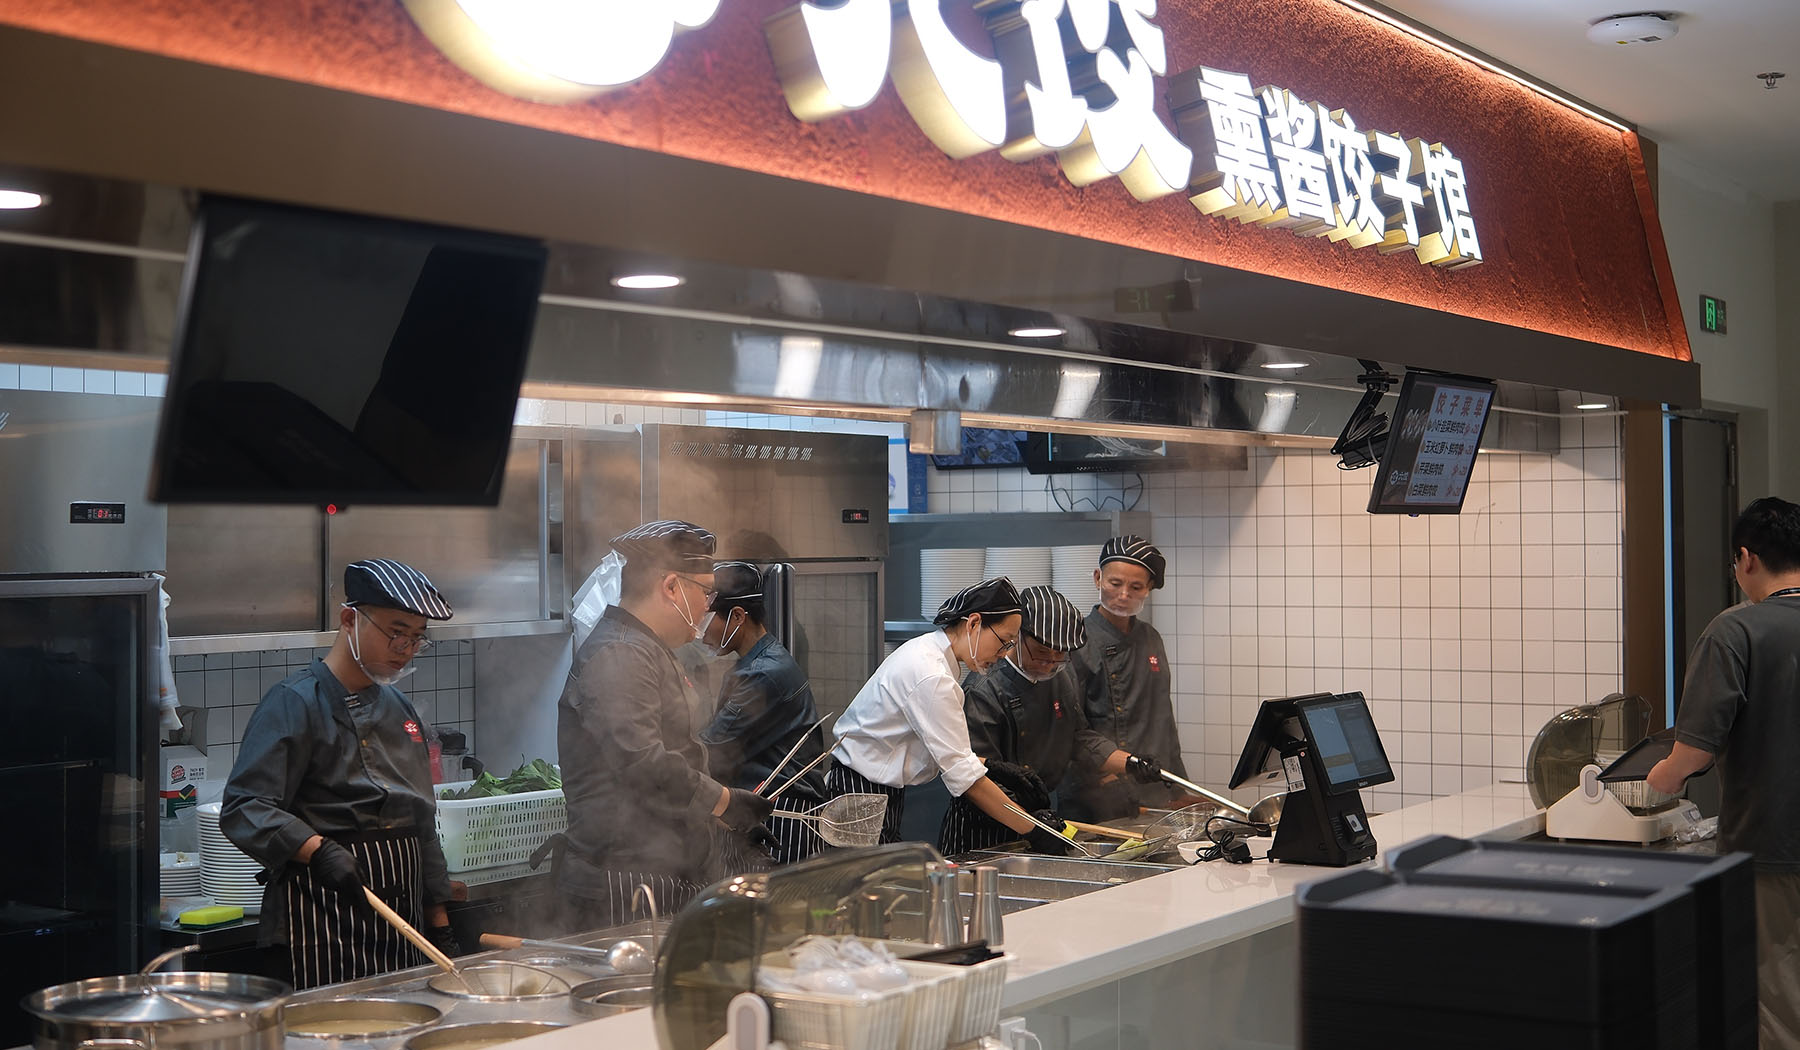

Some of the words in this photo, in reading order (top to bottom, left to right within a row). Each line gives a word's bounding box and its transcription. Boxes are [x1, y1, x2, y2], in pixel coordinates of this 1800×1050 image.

[1197, 65, 1483, 262] 熏酱饺子馆
[1436, 392, 1485, 417] 饺子菜单
